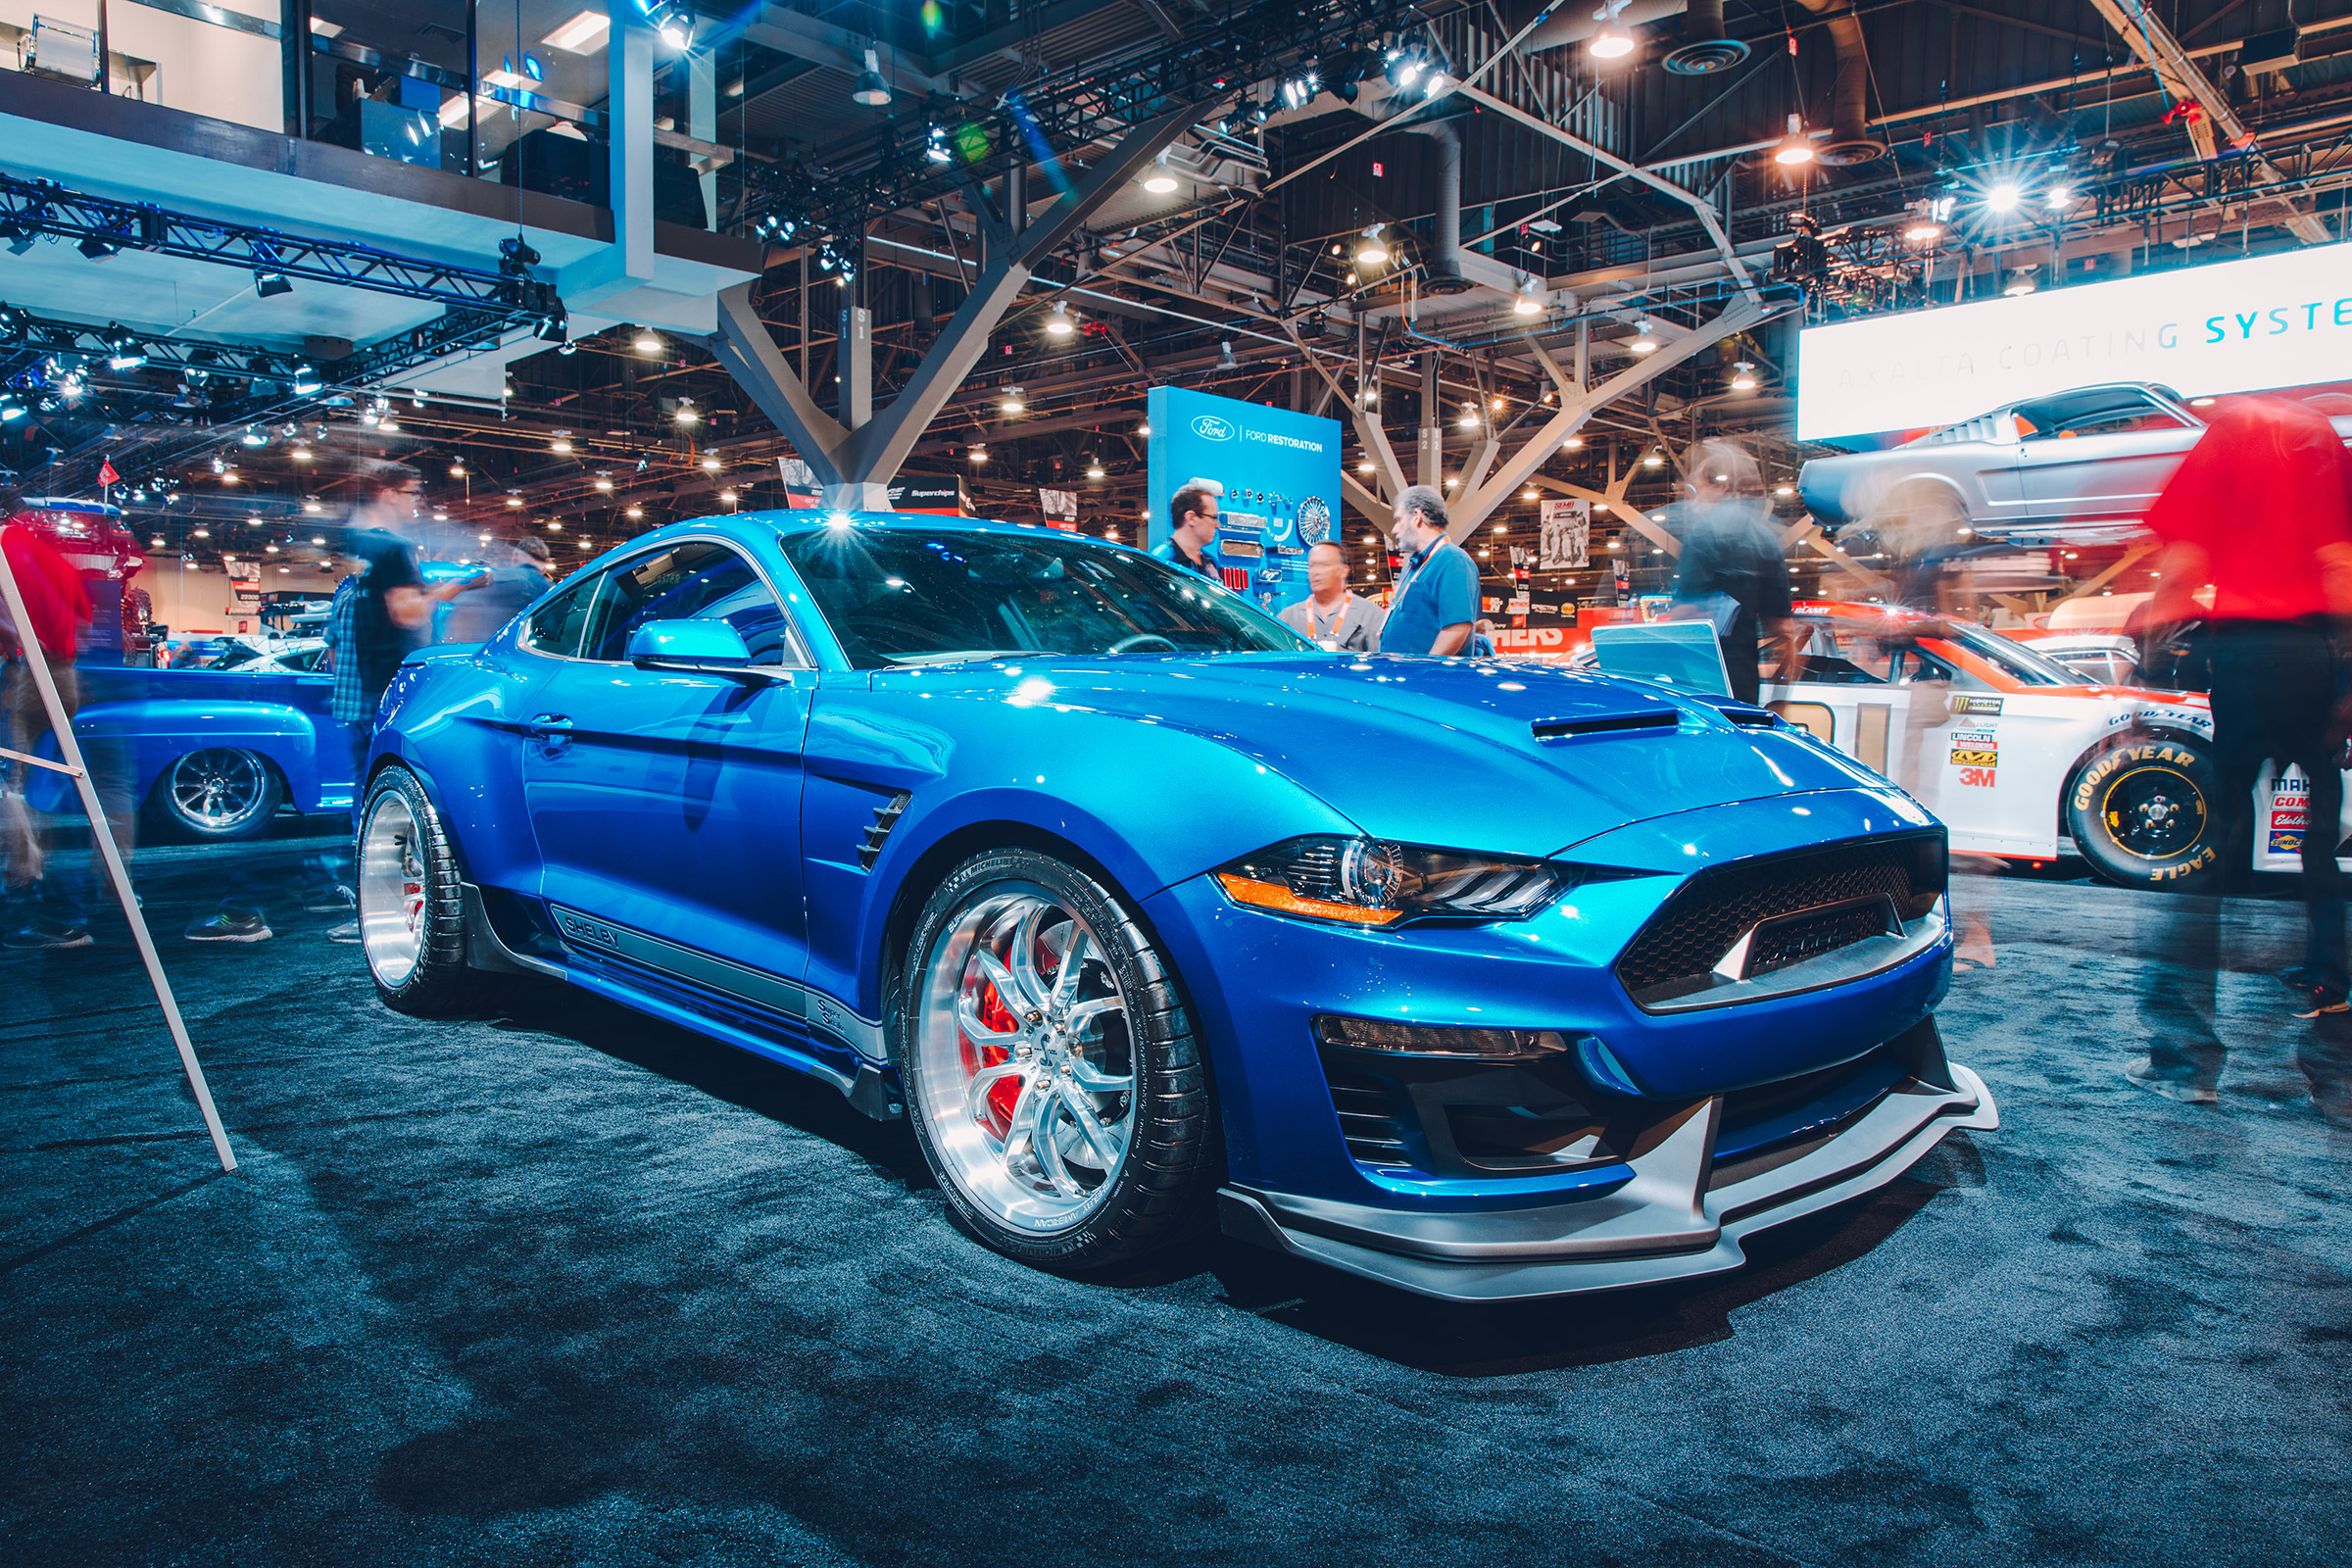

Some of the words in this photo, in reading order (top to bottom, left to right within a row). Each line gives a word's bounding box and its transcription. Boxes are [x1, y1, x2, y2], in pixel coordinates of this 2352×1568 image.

[1999, 323, 2178, 369] COATING
[1199, 417, 1228, 439] Ford
[1246, 429, 1267, 443] FORD
[1267, 433, 1323, 453] RESTORATION
[910, 489, 956, 498] Superchips
[1959, 767, 1996, 788] 3M
[2074, 745, 2195, 811] GOODYEAR
[971, 857, 1014, 873] MICHELIN
[2149, 846, 2217, 881] EAGLE
[564, 916, 619, 949] SHELBY
[948, 905, 970, 934] SUPER
[1082, 1179, 1110, 1214] SHELBY
[1034, 1210, 1079, 1228] AMERICAN
